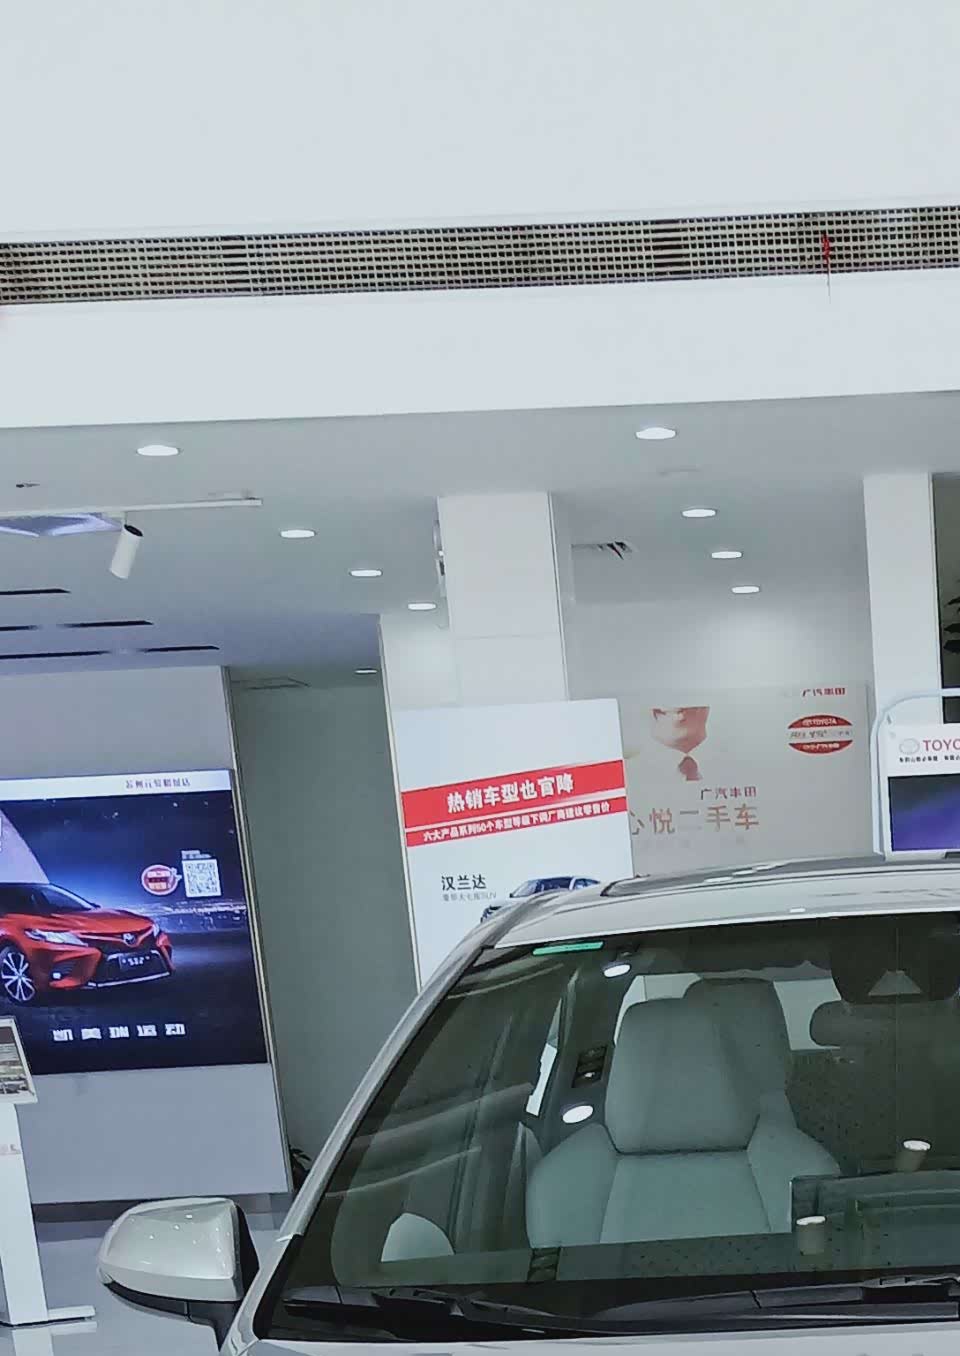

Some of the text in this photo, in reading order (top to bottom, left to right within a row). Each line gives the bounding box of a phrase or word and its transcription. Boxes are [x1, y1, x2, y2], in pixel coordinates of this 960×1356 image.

[447, 773, 574, 814] 热销车型也官降
[700, 786, 757, 800] 广汽丰田
[441, 873, 487, 891] 汉兰达
